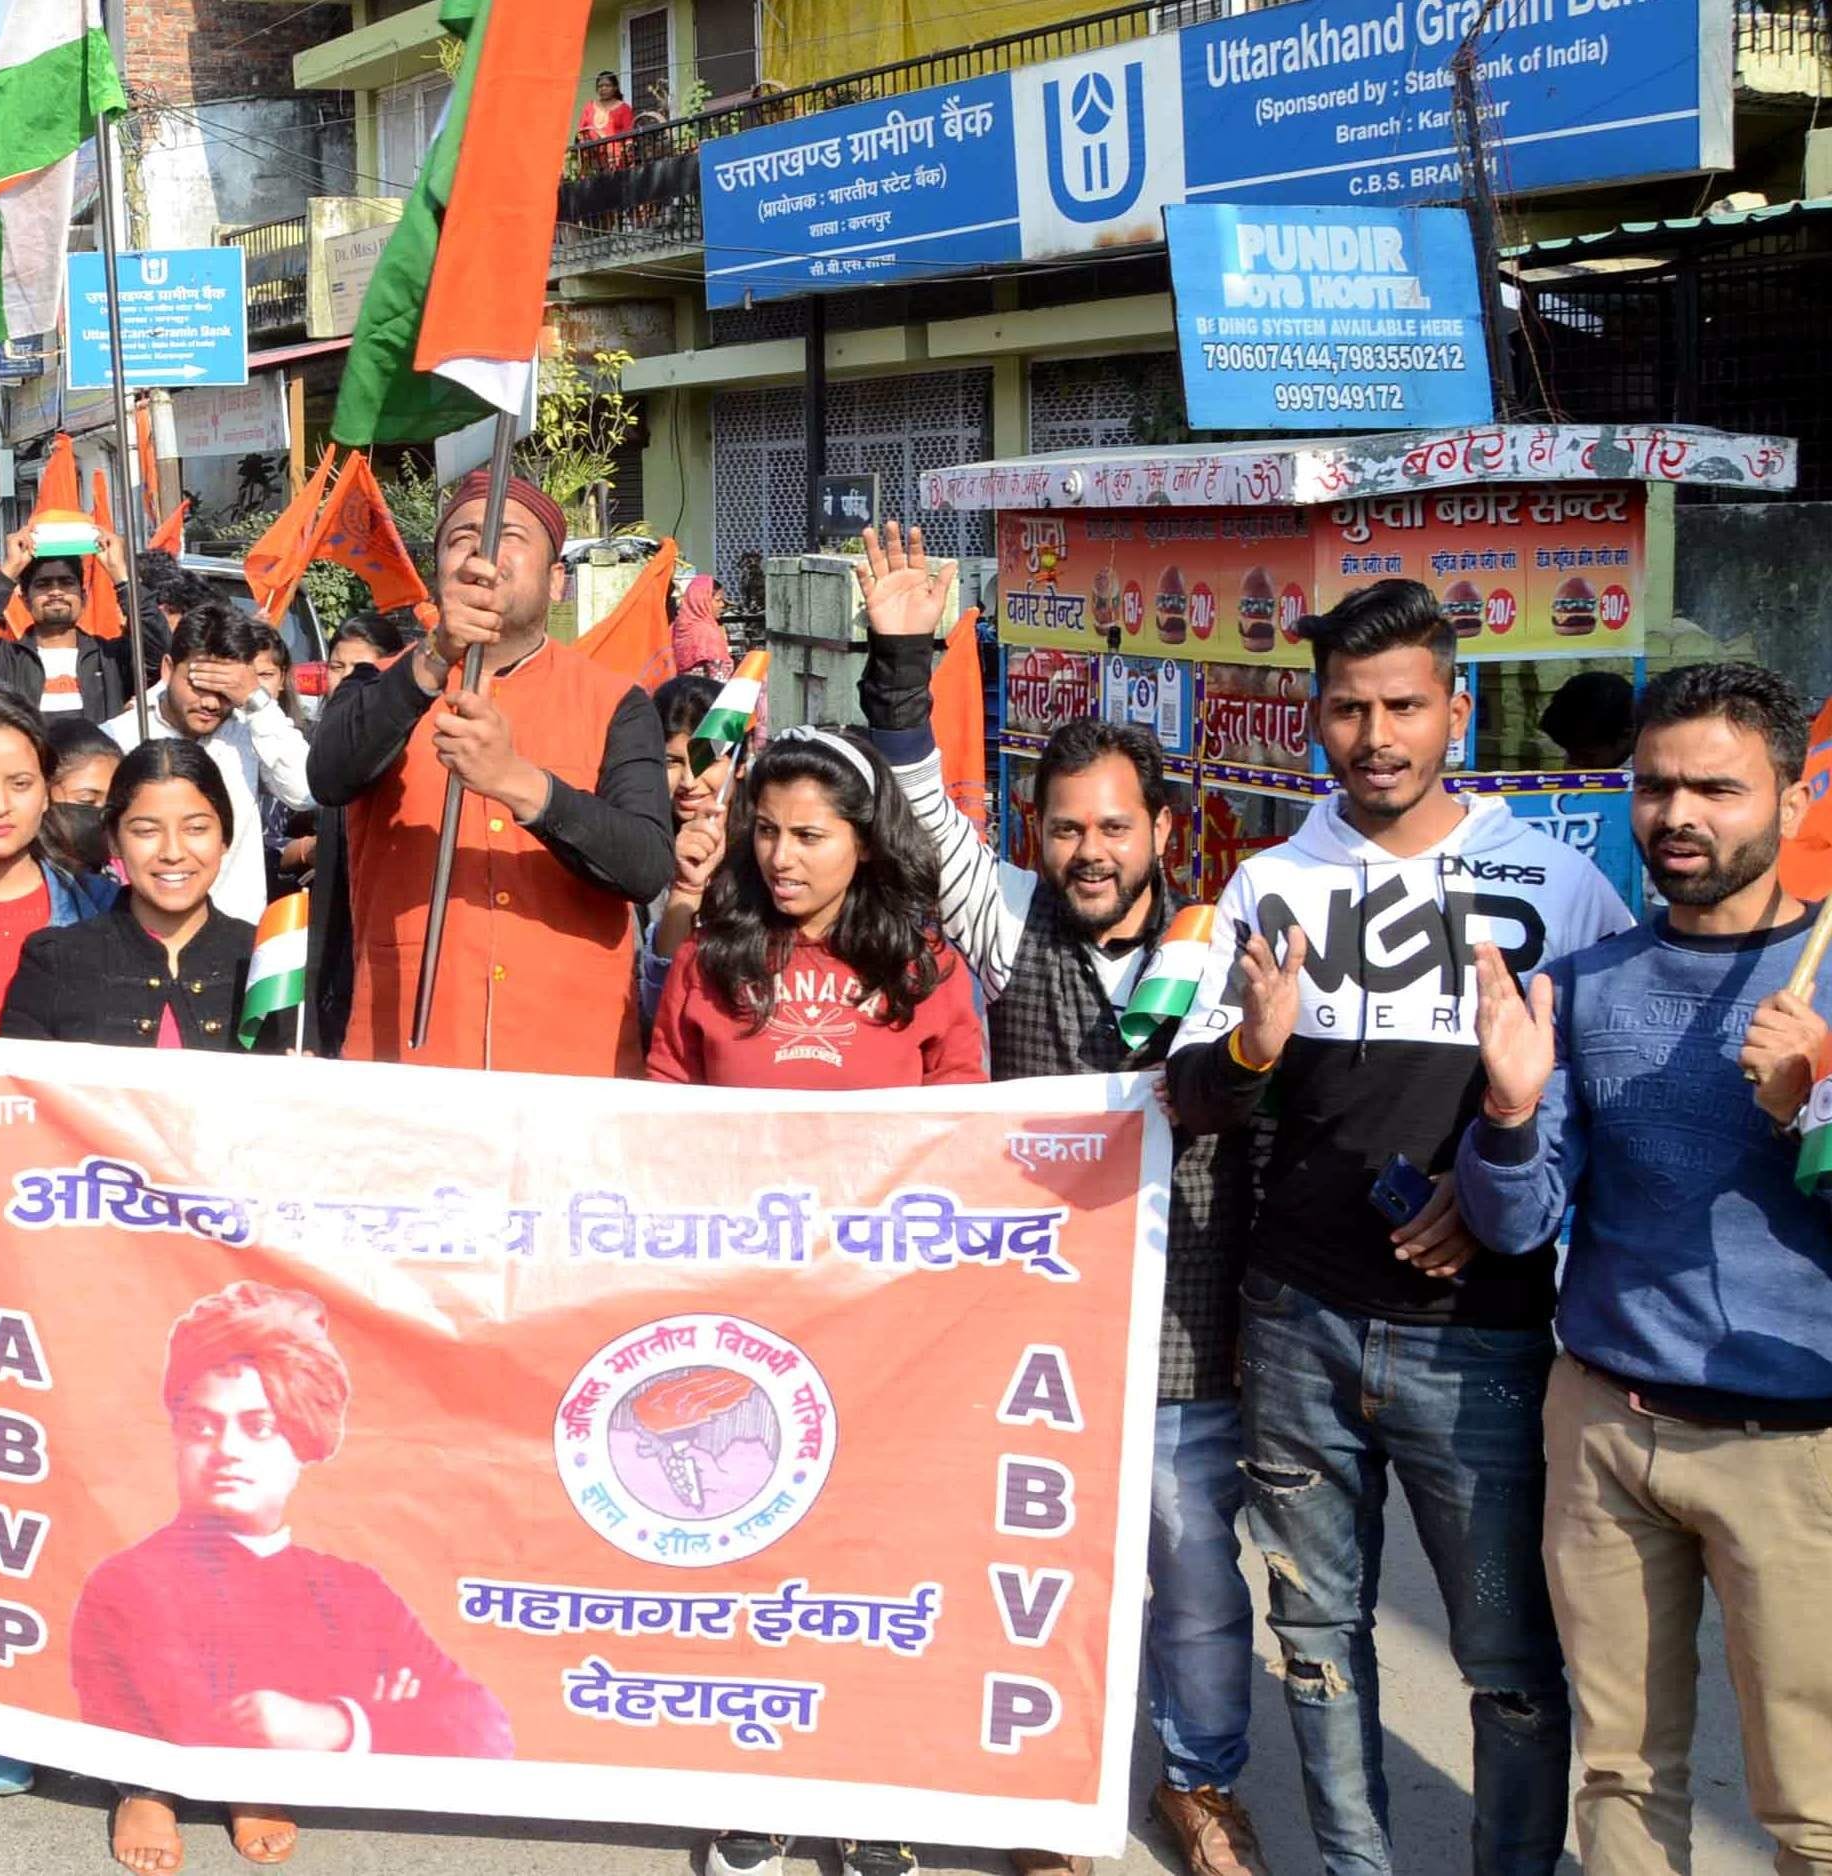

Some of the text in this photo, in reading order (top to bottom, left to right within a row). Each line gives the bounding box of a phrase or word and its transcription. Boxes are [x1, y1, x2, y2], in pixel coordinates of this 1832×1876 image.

[1206, 8, 1406, 90] Uttarakhand
[1256, 84, 1361, 126] (Sponsored
[1363, 79, 1389, 106] by
[1462, 50, 1514, 82] ank
[1518, 49, 1542, 74] of
[1545, 36, 1609, 71] India)
[714, 93, 995, 192] उत्तराखण्ड ग्रामीण बैंक
[1336, 115, 1401, 145] Branch
[827, 177, 878, 205] भारतीय
[881, 170, 912, 194] स्टेट
[1348, 156, 1499, 197] C.B.S. BRANH
[808, 210, 893, 238] शाखा करनपुर
[1235, 223, 1408, 274] PUNDIR
[1309, 274, 1431, 311] HOSTEL
[200, 324, 233, 338] Bank
[1261, 317, 1464, 338] SYSTEM AVAILABLE HERE
[1203, 342, 1466, 376] 7906074144,7983550212
[1274, 384, 1405, 412] 9997949172
[1487, 598, 1516, 624] 20/-
[1601, 594, 1630, 622] 30/-
[1204, 1003, 1460, 1034] DGER
[1004, 1131, 1108, 1171] एकता
[11, 1158, 257, 1244] अखिल
[567, 1189, 812, 1263] विद्यार्थी
[830, 1191, 1074, 1276] परिषद्
[560, 1376, 612, 1442] अखिल
[603, 1325, 698, 1376] भारतीय
[715, 1321, 801, 1378] विद्यार्थी
[581, 1481, 798, 1557] ज्ञान शील एकता
[464, 1582, 938, 1651] महानगर ईकाई
[567, 1660, 819, 1745] देहरादून
